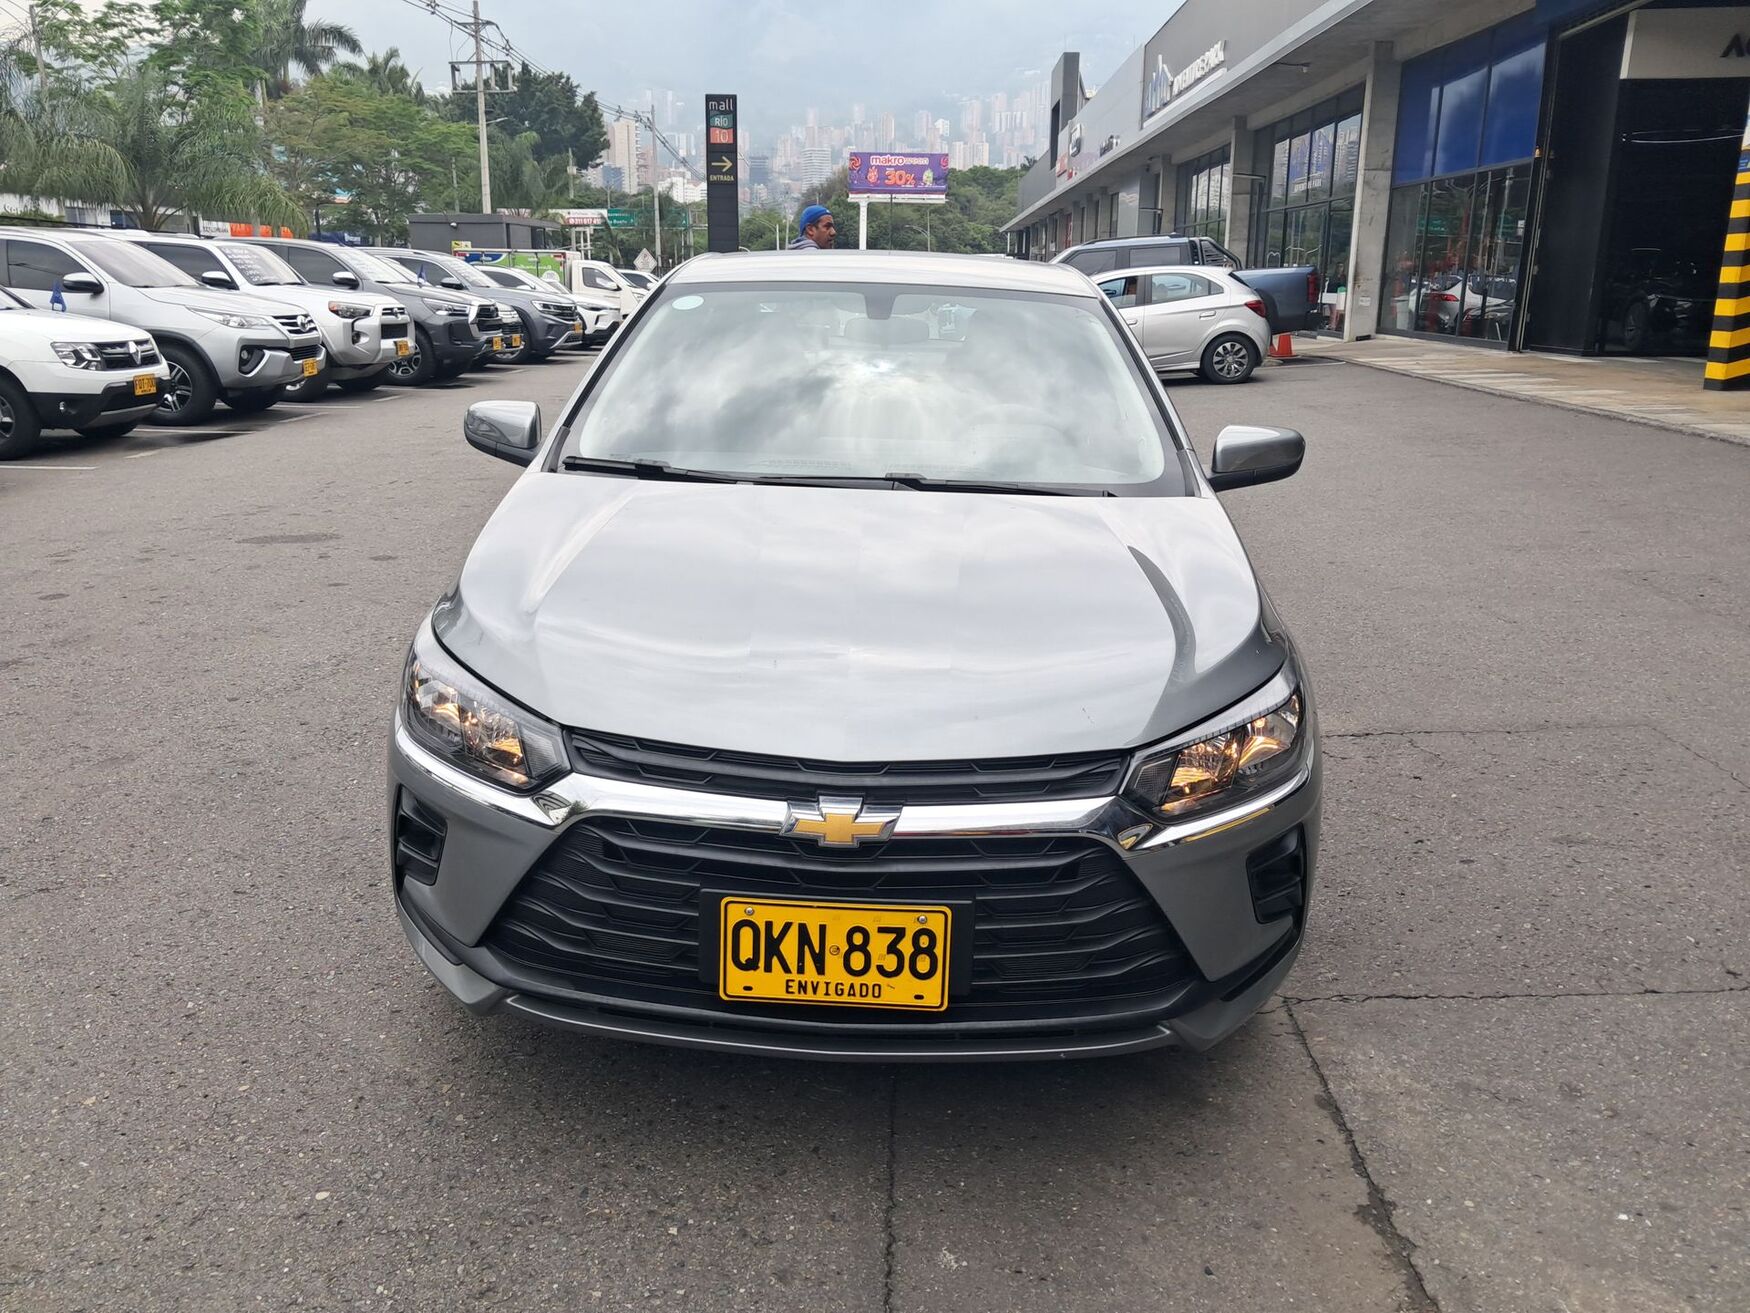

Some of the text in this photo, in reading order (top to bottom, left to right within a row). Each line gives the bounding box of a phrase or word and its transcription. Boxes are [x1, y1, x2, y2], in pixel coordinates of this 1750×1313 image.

[709, 98, 733, 111] mall
[716, 130, 729, 143] 10
[709, 174, 735, 182] ENTRADA
[885, 170, 916, 185] 30%
[731, 919, 938, 980] QKN 838
[785, 979, 882, 998] ENVIGADO
